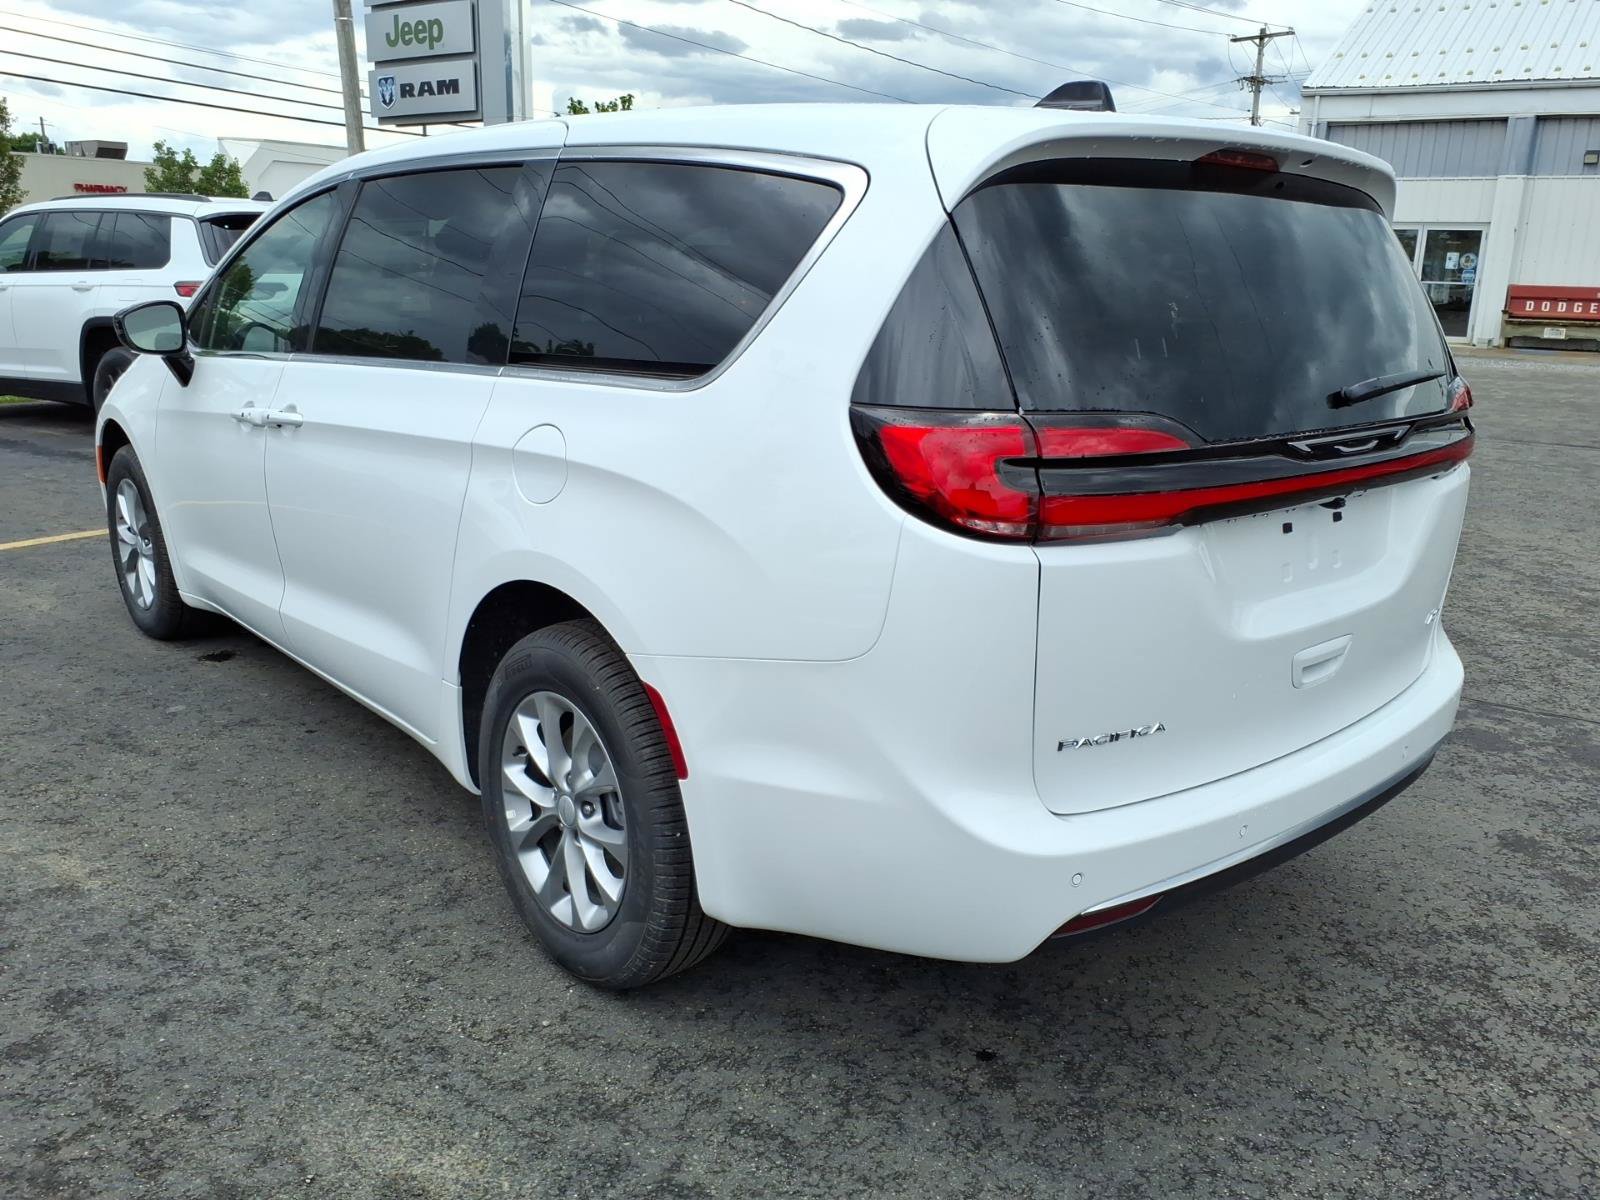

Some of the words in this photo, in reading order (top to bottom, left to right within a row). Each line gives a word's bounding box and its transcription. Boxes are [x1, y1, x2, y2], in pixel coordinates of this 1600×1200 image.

[386, 14, 443, 50] Jeep
[400, 79, 460, 99] RAM
[74, 183, 127, 193] PHARMACY
[1525, 301, 1599, 314] DODGE
[1057, 721, 1166, 752] PACIFICA
